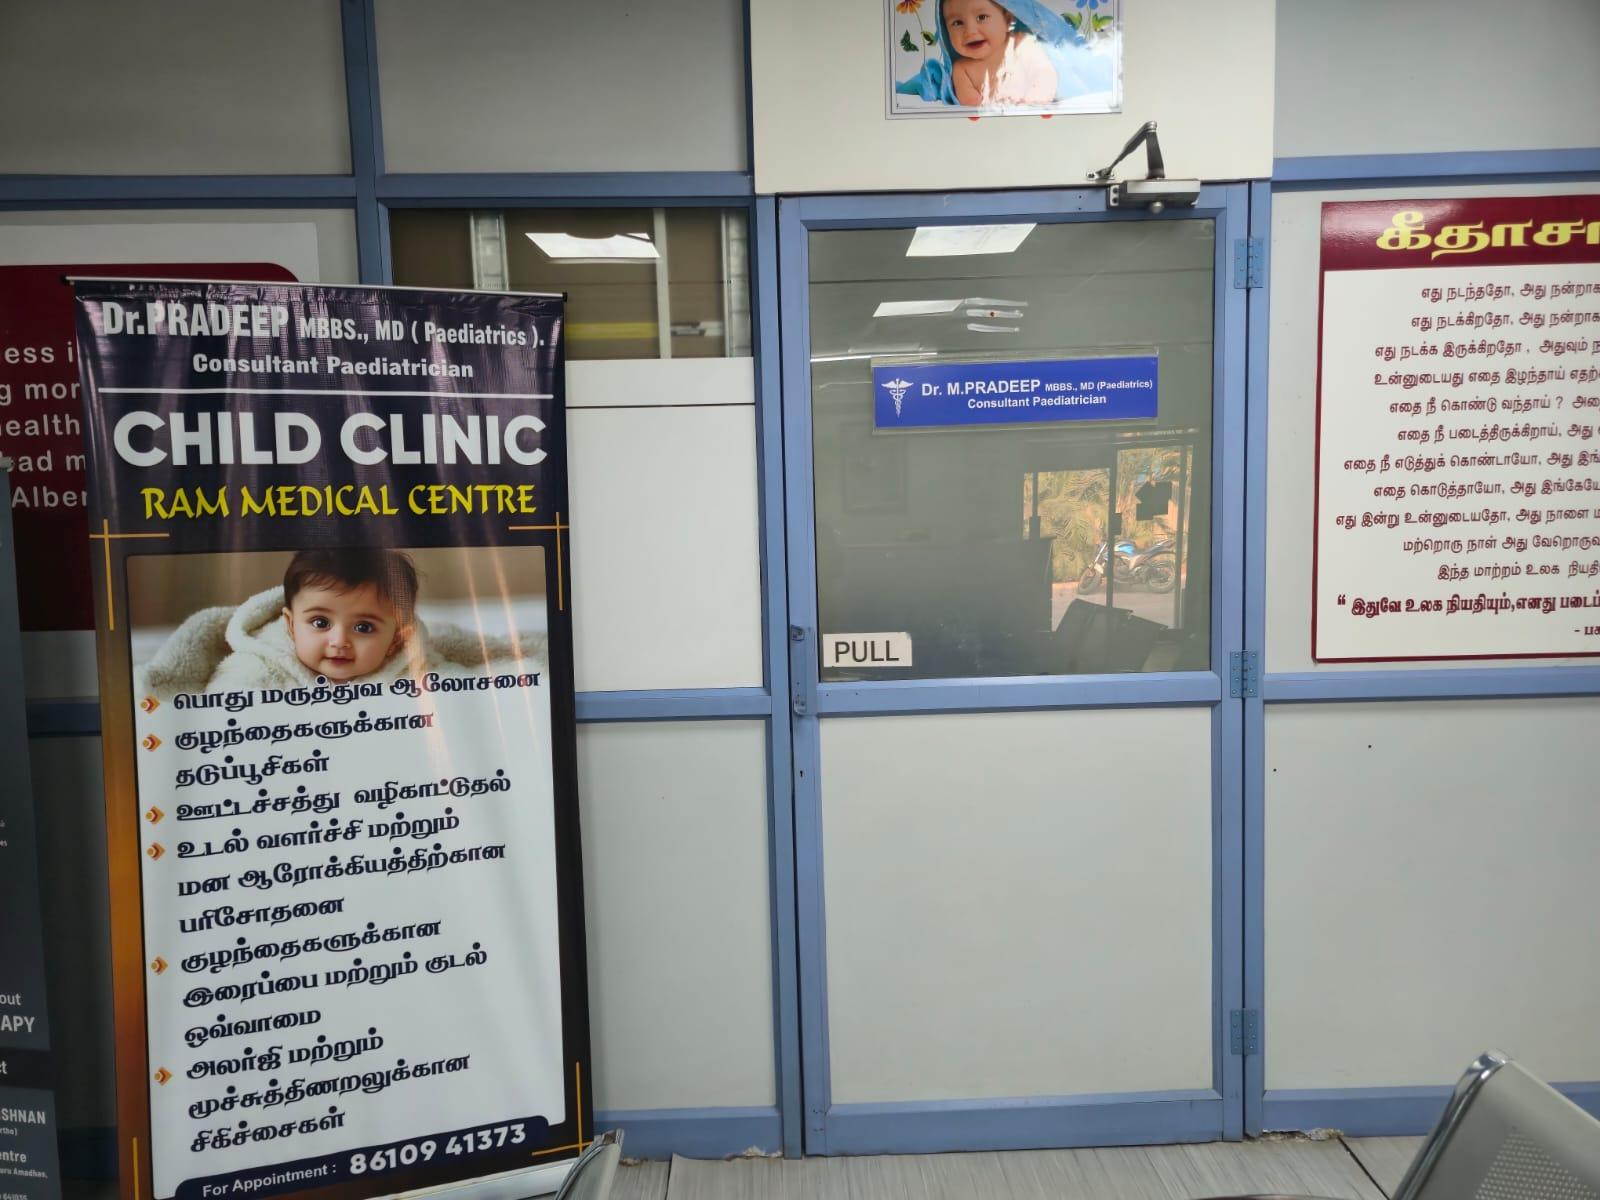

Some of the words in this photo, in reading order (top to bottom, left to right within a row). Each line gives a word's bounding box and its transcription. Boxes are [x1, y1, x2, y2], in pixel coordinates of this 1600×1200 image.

[1520, 283, 1546, 300] அது
[102, 301, 289, 338] Dr.PRADEEP
[300, 315, 369, 345] MBBS.,
[376, 318, 405, 341] MD
[424, 323, 527, 347] Paediatrics
[1519, 311, 1545, 328] அது
[1400, 341, 1438, 361] நடக்க
[193, 354, 320, 375] Consultant
[327, 357, 474, 379] Paediatrician
[921, 383, 943, 396] Dr.
[947, 379, 1041, 396] M.PRADEEP
[1045, 382, 1078, 393] MBBS.,
[1080, 382, 1095, 391] MD
[1096, 379, 1153, 392] (Paediatrics)
[1374, 370, 1463, 389] உன்னுடையது
[1468, 372, 1500, 386] எதை
[967, 397, 1030, 410] Consultant
[1033, 394, 1107, 408] Paediatrician
[1389, 401, 1422, 416] எதை
[1426, 396, 1436, 416] நீ
[1501, 394, 1550, 414] வந்தாய்
[112, 410, 322, 468] CHILD
[340, 414, 548, 467] CLINIC
[1398, 429, 1430, 444] எதை
[1434, 424, 1444, 444] நீ
[1567, 423, 1593, 440] அது
[1344, 459, 1376, 474] எதை
[1380, 454, 1390, 474] நீ
[1547, 452, 1573, 468] அது
[140, 486, 229, 520] RAM
[241, 484, 399, 519] MEDICAL
[408, 484, 537, 515] CENTRE
[1374, 486, 1406, 501] எதை
[1510, 481, 1536, 497] அது
[1361, 511, 1399, 529] இன்று
[1515, 508, 1541, 525] அது
[1545, 509, 1589, 525] நாளை
[1467, 535, 1497, 553] நாள்
[1502, 536, 1527, 552] அது
[1438, 563, 1469, 581] இந்த
[1474, 561, 1521, 579] மாற்றம்
[1525, 564, 1560, 575] உலக
[1351, 597, 1401, 618] இதுவே
[1406, 599, 1442, 613] உலக
[835, 640, 900, 663] PULL
[174, 691, 253, 712] பொது
[261, 676, 382, 706] மருத்துவ
[389, 672, 541, 698] ஆலோசனை
[175, 710, 435, 754] குழந்தைகளுக்கான
[175, 749, 330, 789] தடுப்பூசிகள்
[176, 785, 340, 822] ஊட்டச்சத்து
[354, 769, 511, 809] வழிகாட்டுதல்
[177, 828, 249, 859] உடல்
[256, 819, 363, 851] வளர்ச்சி
[368, 806, 460, 840] மற்றும்
[178, 872, 229, 897] மன
[238, 842, 506, 890] ஆரோக்கியத்திற்கான
[179, 897, 345, 934] பரிசோதனை
[181, 920, 442, 974] குழந்தைகளுக்கான
[183, 970, 318, 1008] இரைப்பை
[325, 951, 418, 985] மற்றும்
[425, 942, 488, 973] குடல்
[184, 1008, 321, 1048] ஒவ்வாமை
[186, 1045, 282, 1081] அலர்ஜி
[288, 1027, 384, 1064] மற்றும்
[190, 1105, 346, 1153] சிகிச்சைகள்
[0, 1151, 27, 1163] ntre
[202, 1182, 229, 1198] For
[232, 1167, 328, 1194] Appointment
[349, 1140, 438, 1175] 86109
[445, 1123, 527, 1155] 41373
